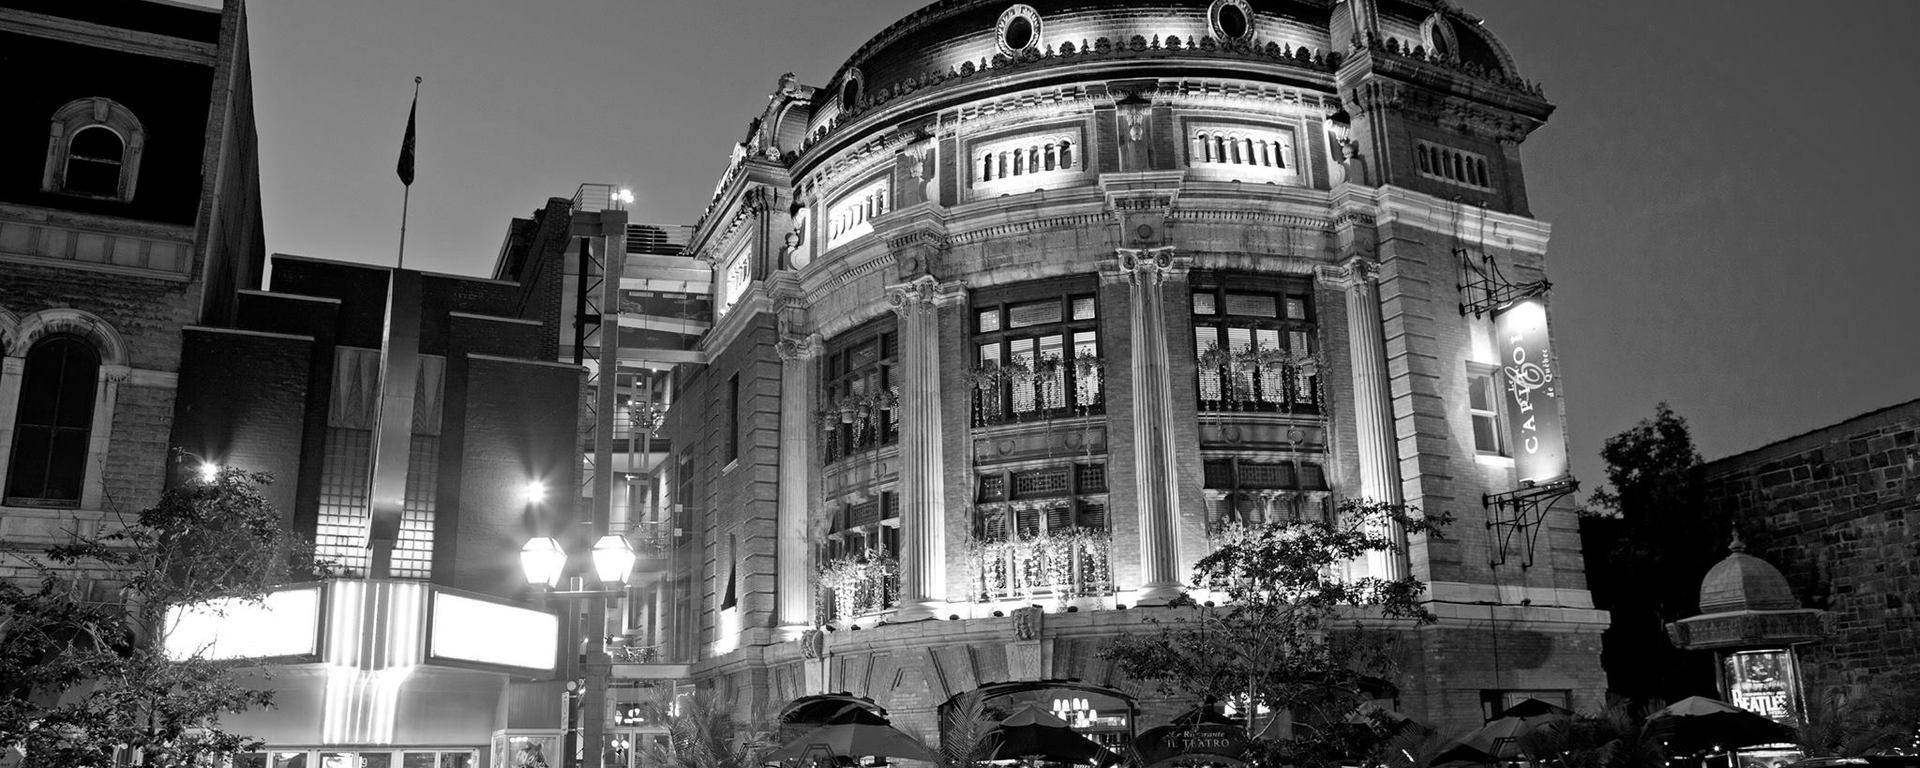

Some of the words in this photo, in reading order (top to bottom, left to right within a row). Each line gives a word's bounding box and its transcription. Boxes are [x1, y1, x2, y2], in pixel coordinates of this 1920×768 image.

[1546, 386, 1554, 398] de
[1183, 730, 1225, 738] Riorante
[1182, 738, 1230, 748] TEATRO
